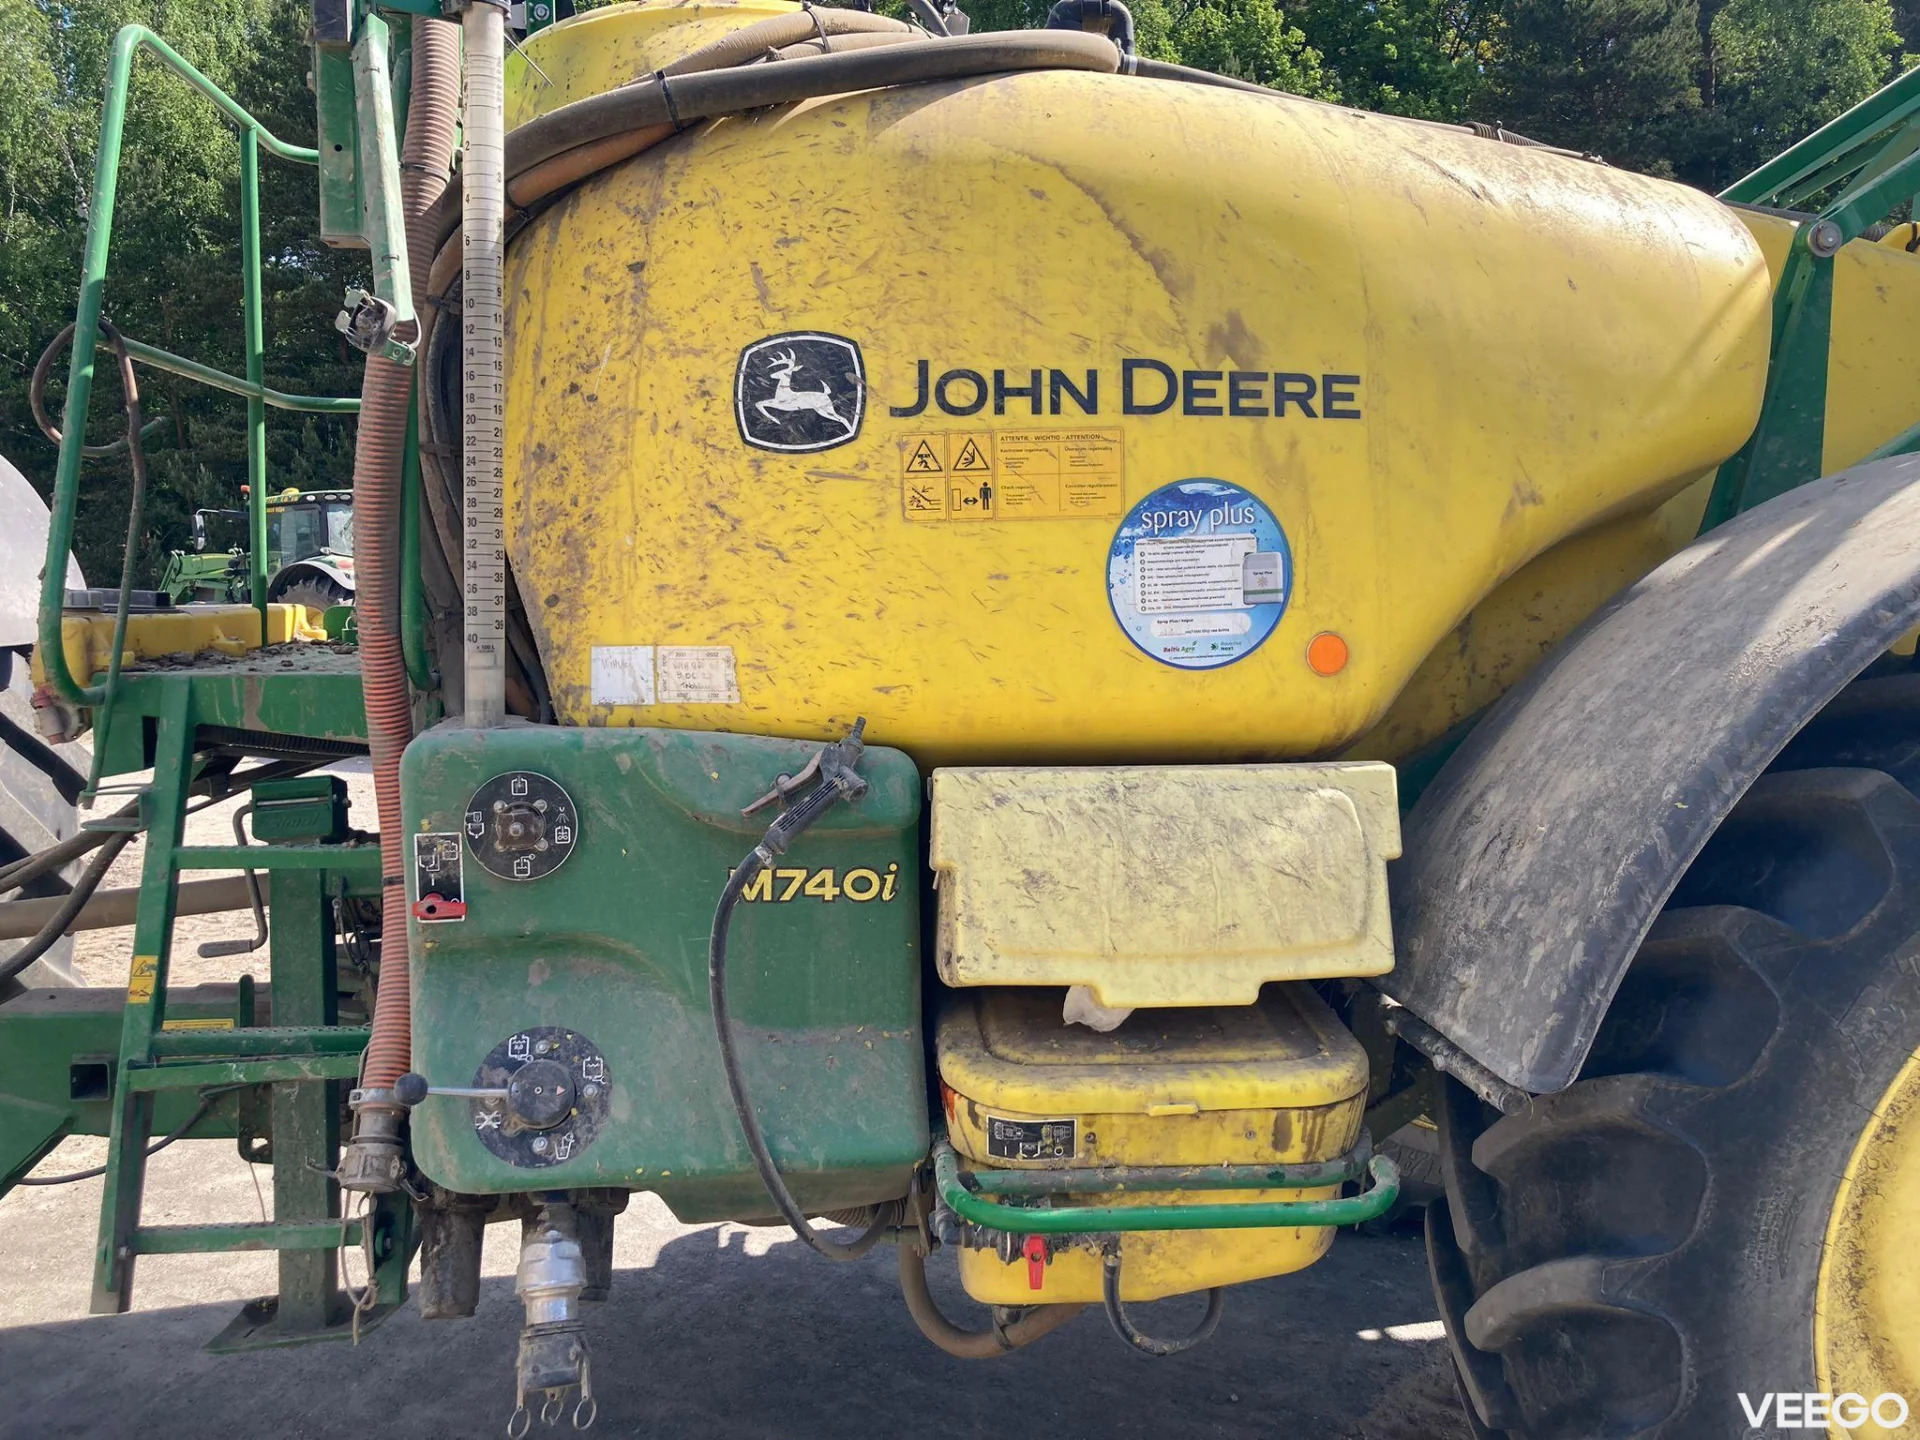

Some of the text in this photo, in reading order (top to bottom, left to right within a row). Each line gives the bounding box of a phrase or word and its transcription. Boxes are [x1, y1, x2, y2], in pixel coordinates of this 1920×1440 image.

[465, 140, 470, 151] 2
[465, 193, 470, 204] 4
[465, 235, 470, 246] 6
[497, 256, 502, 266] 7
[465, 270, 470, 280] 8
[496, 286, 502, 297] 9
[465, 298, 475, 309] 10
[494, 312, 502, 324] 11
[465, 324, 475, 334] 12
[493, 336, 502, 348] 13
[465, 347, 475, 357] 14
[493, 360, 502, 371] 15
[465, 370, 475, 381] 16
[493, 383, 502, 394] 17
[889, 359, 1362, 419] JOHN DEERE
[465, 393, 475, 403] 18
[493, 404, 502, 415] 19
[465, 413, 476, 425] 20
[493, 427, 503, 437] 21
[466, 436, 477, 446] 22
[493, 447, 503, 458] 23
[466, 456, 477, 466] 24
[493, 467, 503, 478] 25
[466, 476, 477, 487] 26
[493, 488, 503, 498] 27
[466, 497, 477, 508] 28
[493, 507, 503, 518] 29
[1141, 501, 1255, 534] spray plus
[466, 517, 477, 527] 30
[494, 528, 503, 539] 31
[466, 539, 477, 549] 32
[495, 550, 503, 560] 33
[466, 560, 477, 570] 34
[494, 572, 503, 583] 35
[466, 583, 478, 594] 36
[494, 595, 503, 606] 37
[466, 606, 478, 616] 38
[494, 619, 503, 630] 39
[467, 633, 478, 643] 40
[729, 863, 898, 902] M740i
